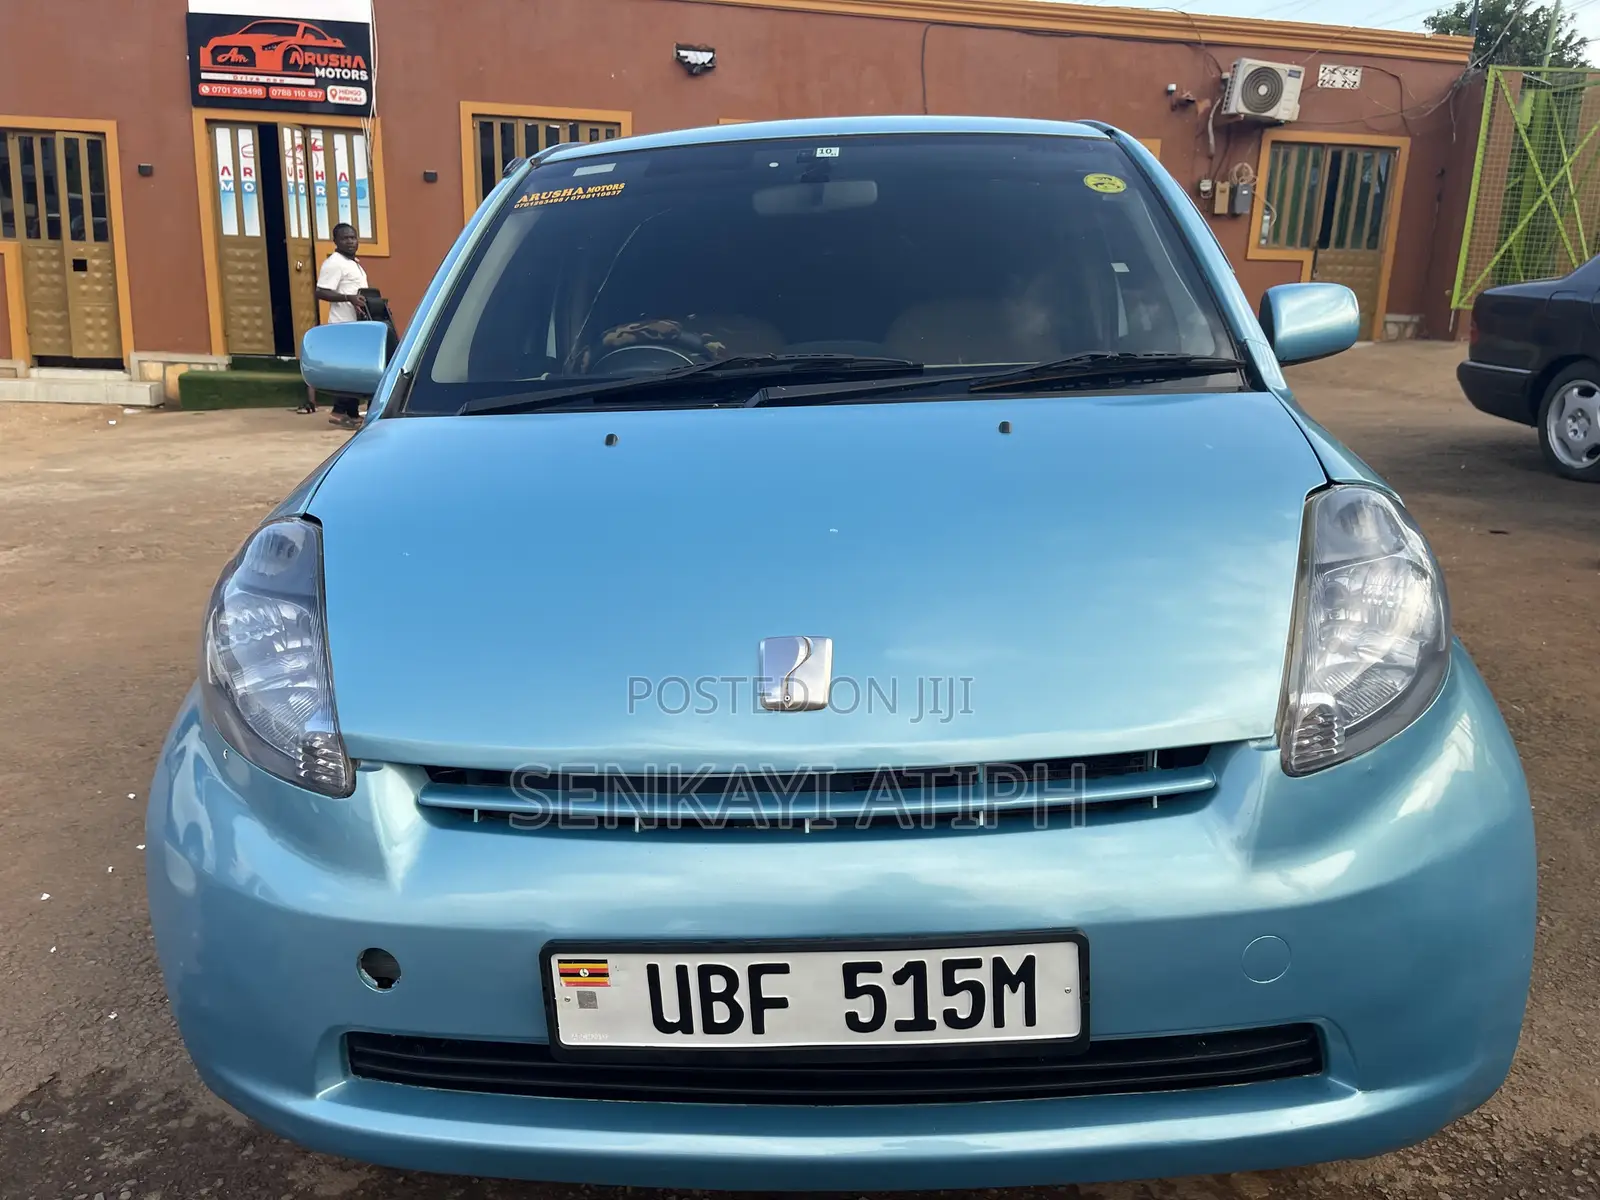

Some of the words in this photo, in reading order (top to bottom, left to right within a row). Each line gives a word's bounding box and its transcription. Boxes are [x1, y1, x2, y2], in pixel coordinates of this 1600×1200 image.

[216, 47, 248, 62] Am
[289, 51, 366, 69] ARUSHA
[314, 67, 369, 81] MOTORS
[211, 86, 231, 94] 0701
[271, 89, 291, 97] 0788
[517, 186, 584, 203] ARUSHA
[587, 183, 626, 194] MOTORS
[646, 963, 790, 1036] UBF
[842, 954, 1037, 1033] 515M
